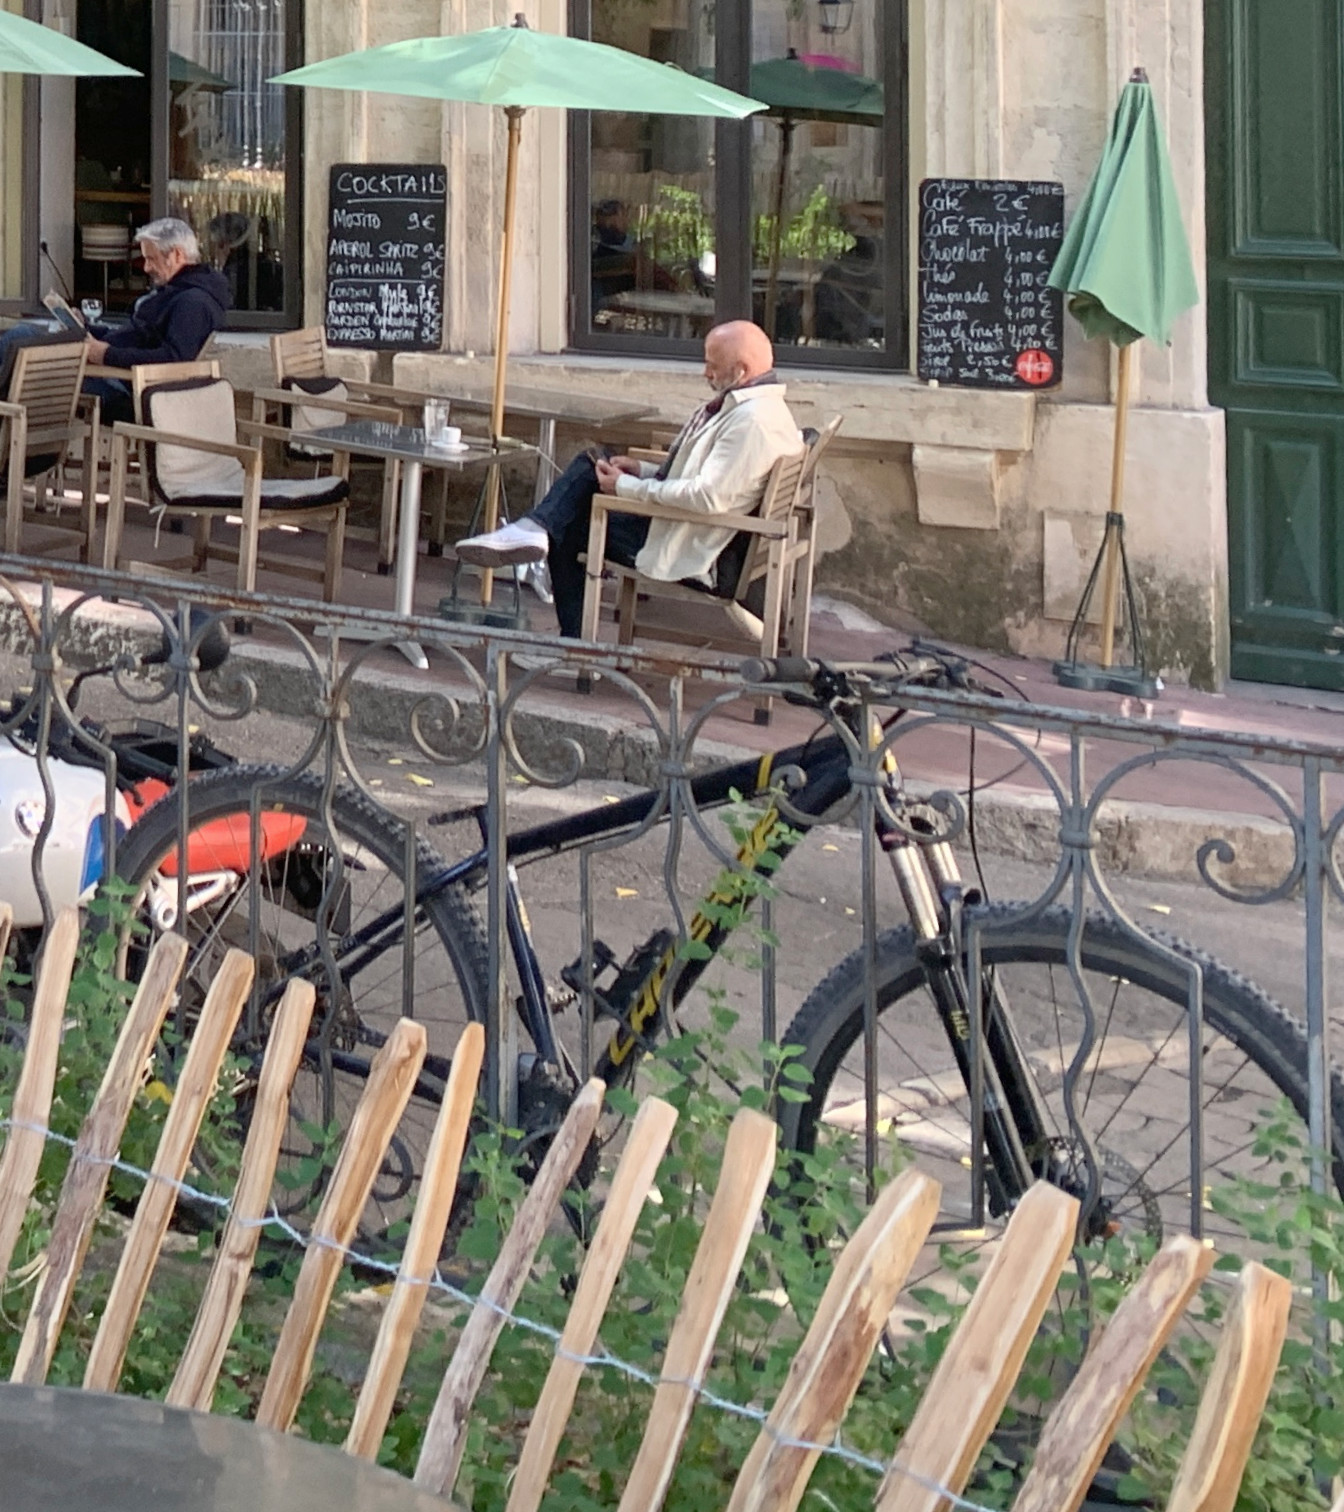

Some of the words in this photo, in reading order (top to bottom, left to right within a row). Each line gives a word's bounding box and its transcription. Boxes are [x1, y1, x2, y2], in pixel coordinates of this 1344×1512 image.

[336, 172, 446, 194] COCKTAILS
[923, 183, 968, 211] Café
[966, 214, 1027, 247] Frappé
[329, 238, 374, 258] APEROL
[920, 238, 990, 262] Chocolat
[920, 323, 947, 339] Jus
